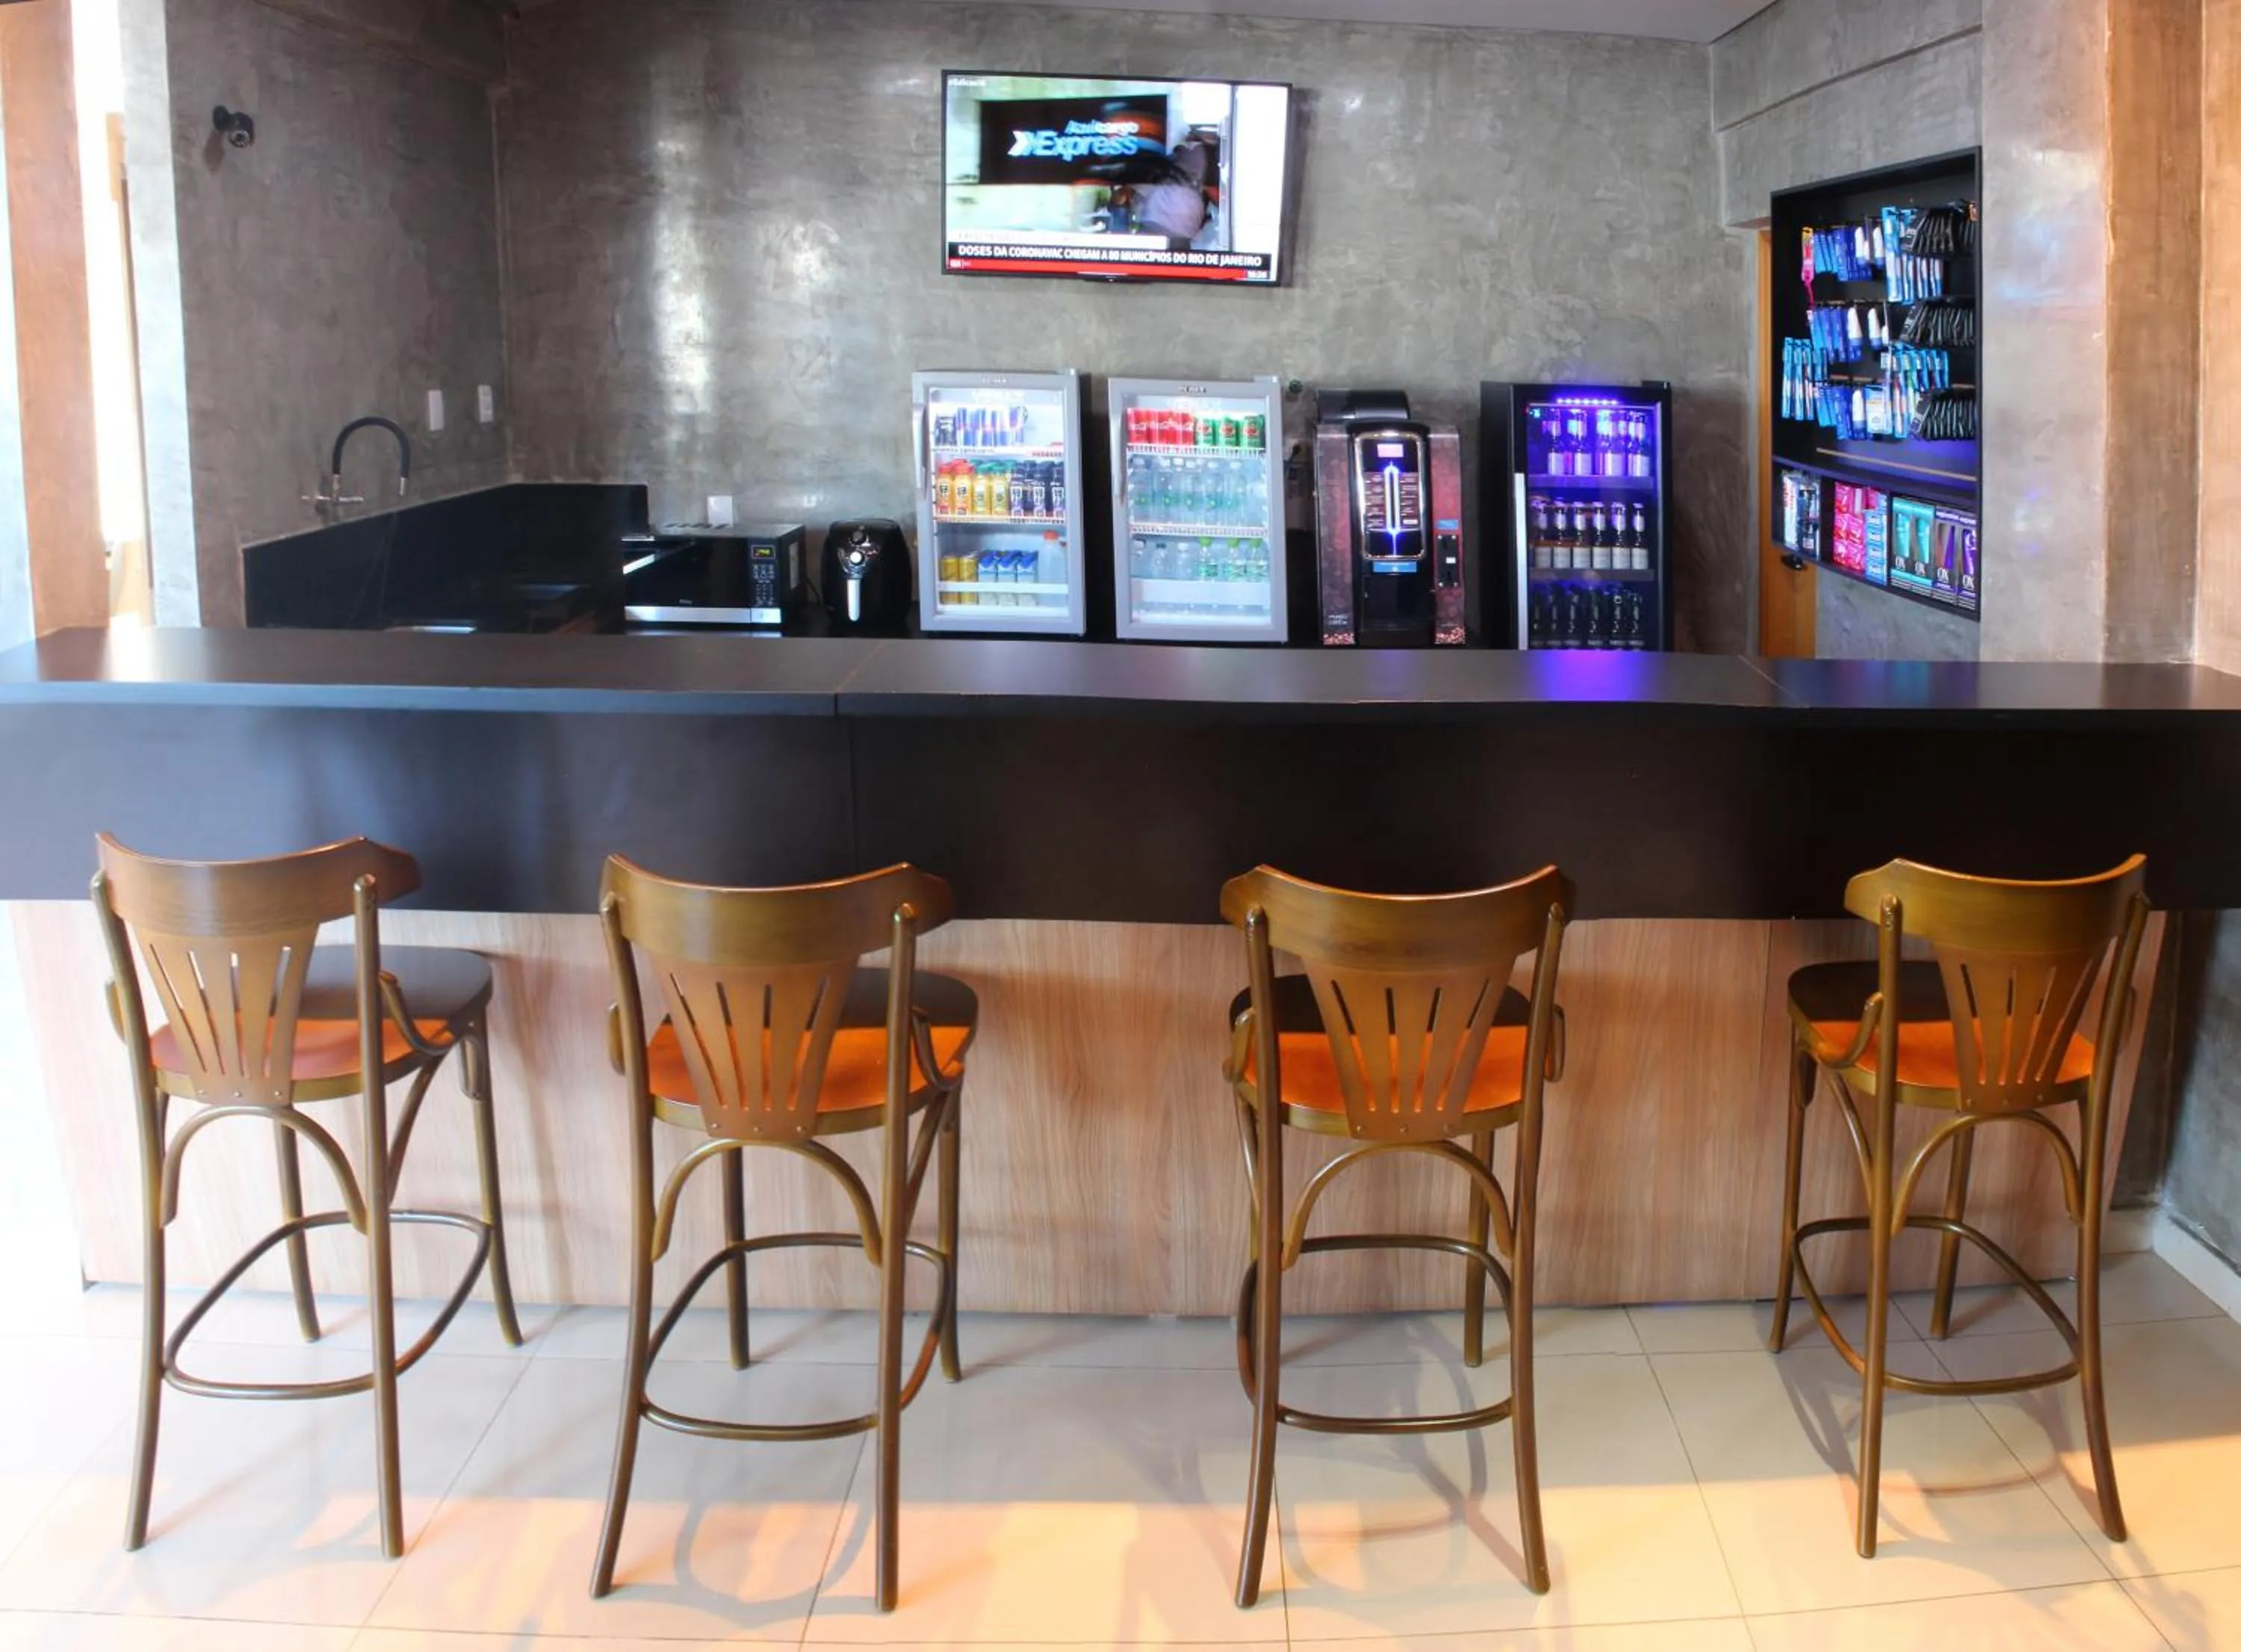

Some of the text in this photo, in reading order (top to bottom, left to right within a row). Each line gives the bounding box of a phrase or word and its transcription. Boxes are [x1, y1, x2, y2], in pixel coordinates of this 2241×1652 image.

[1034, 131, 1138, 161] Express
[958, 245, 992, 256] DOSES
[994, 246, 1007, 257] DA
[1008, 246, 1063, 258] CORONAVAC
[1173, 252, 1186, 263] DO
[1188, 253, 1204, 264] RIO
[1206, 254, 1219, 264] DE
[1220, 255, 1262, 267] JANEIRO
